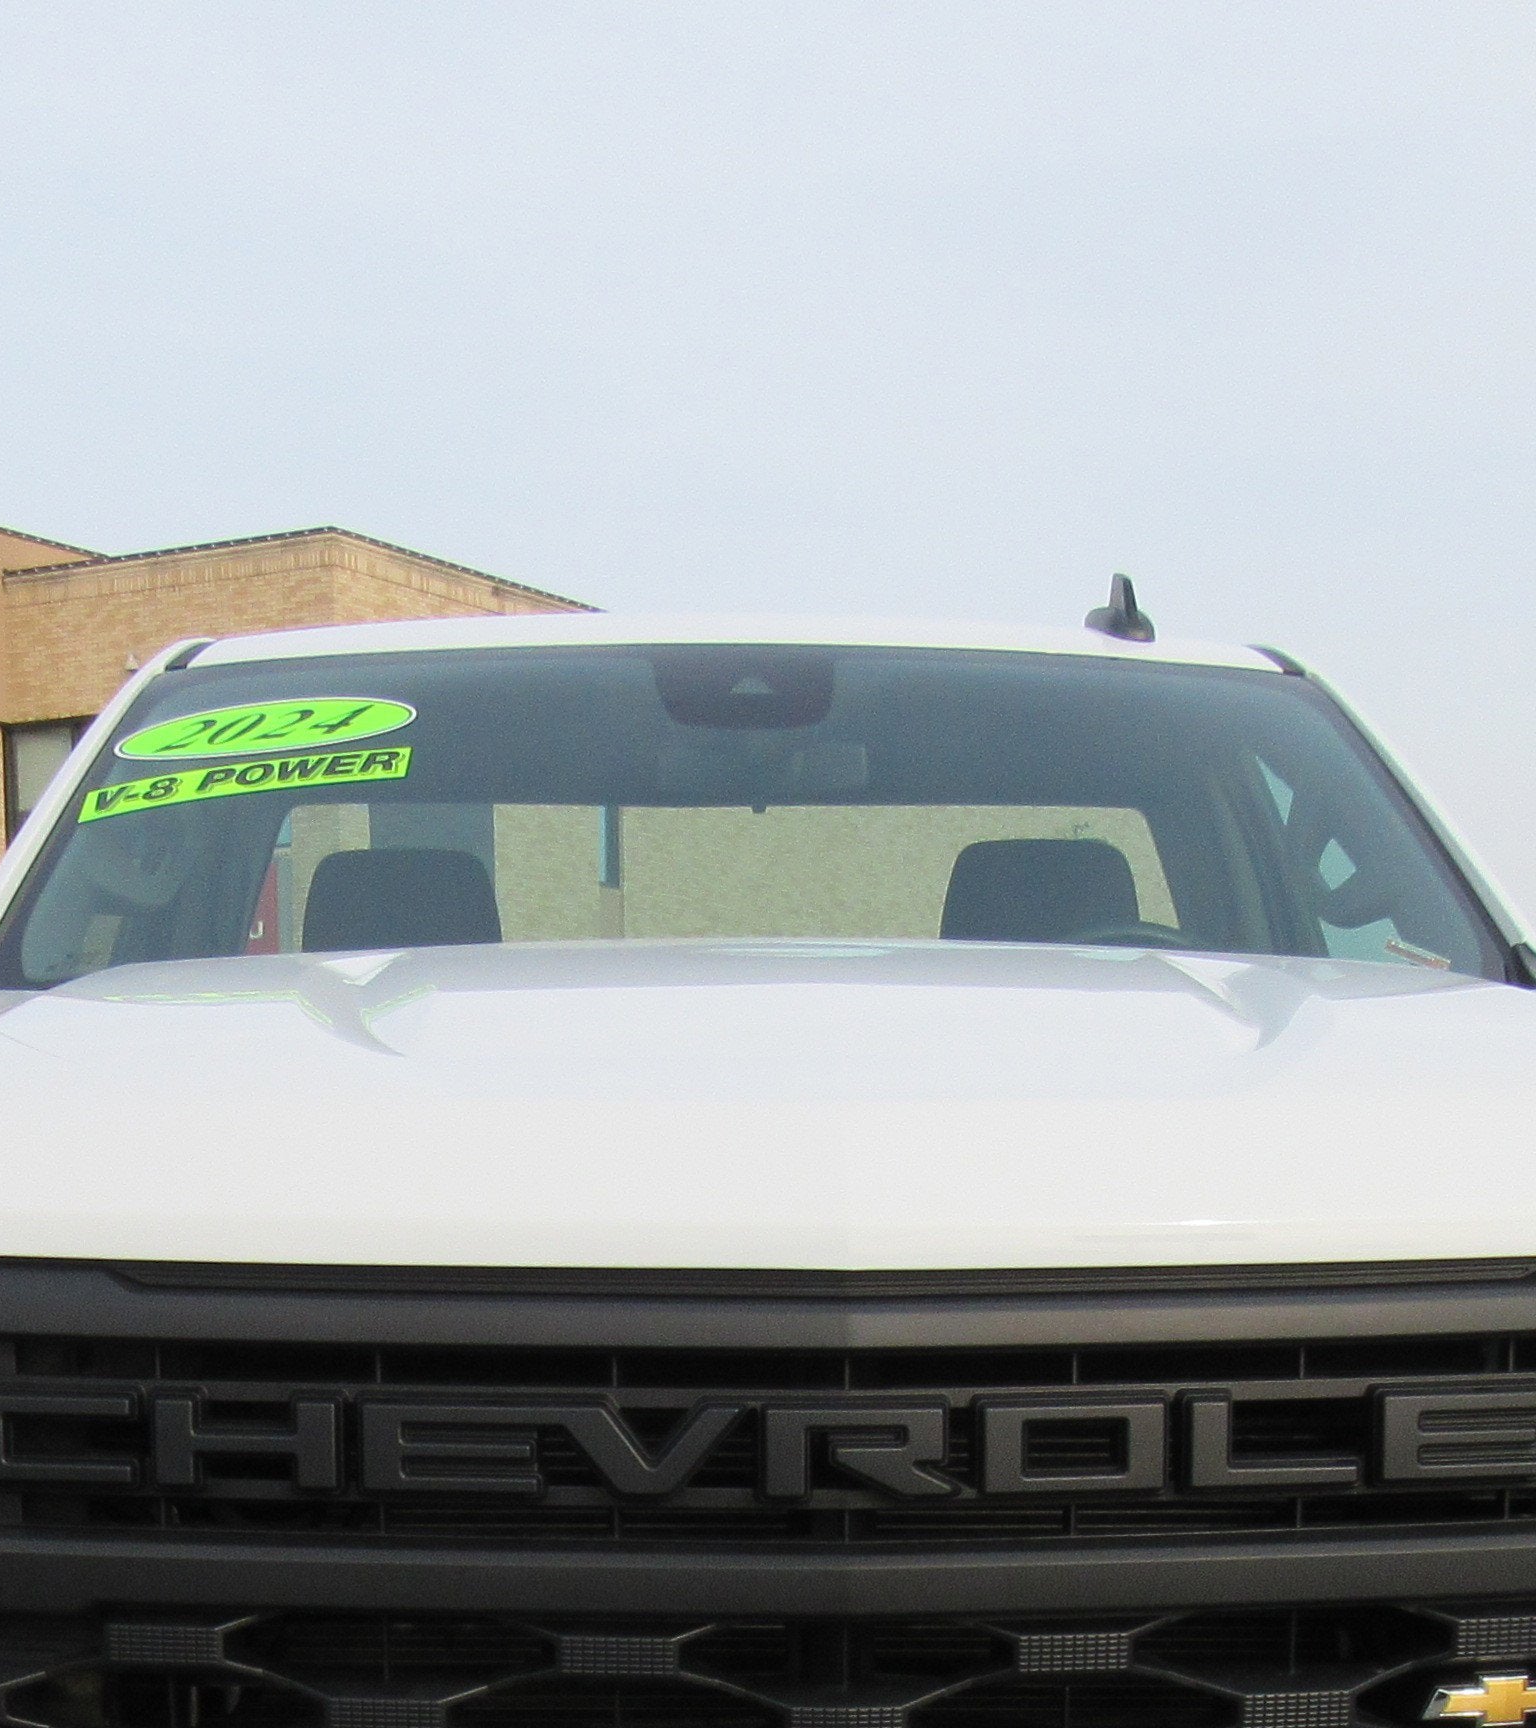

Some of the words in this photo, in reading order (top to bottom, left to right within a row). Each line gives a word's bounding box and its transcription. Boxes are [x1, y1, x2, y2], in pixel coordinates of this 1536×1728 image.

[154, 704, 375, 753] 2024
[94, 776, 183, 815] V-8
[194, 750, 407, 797] POWER
